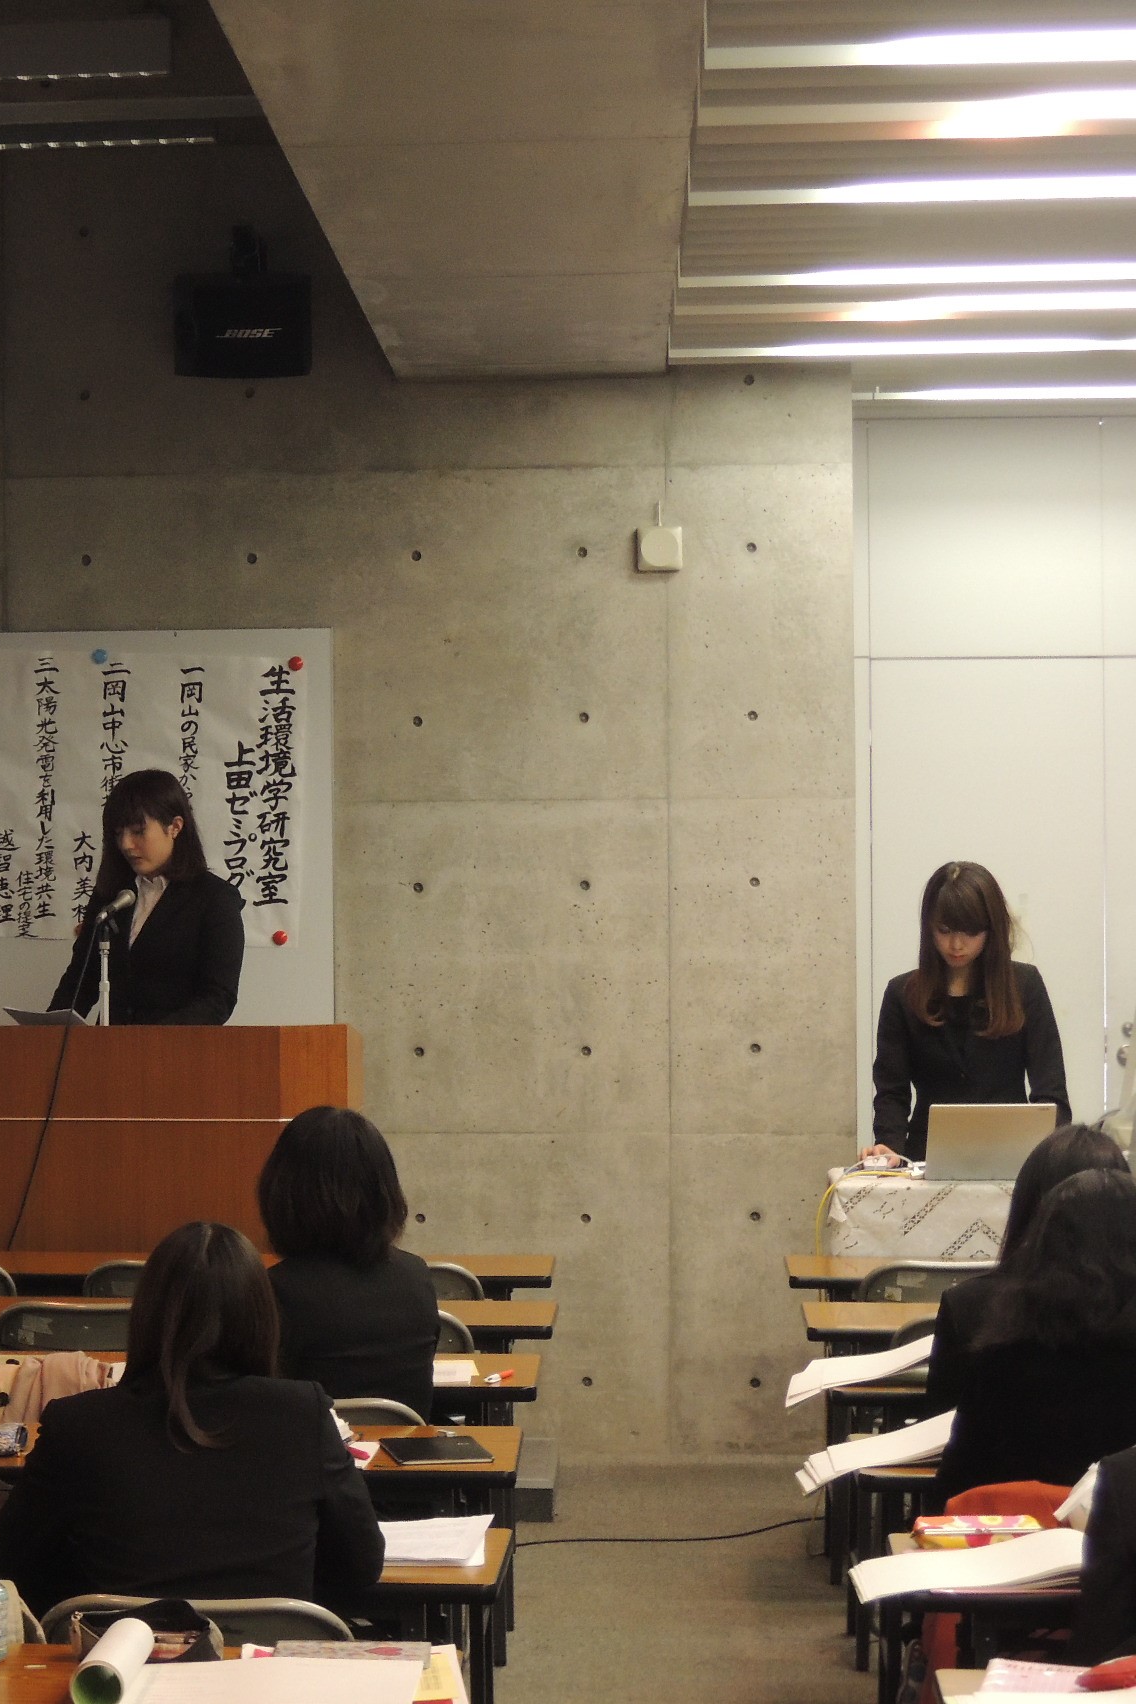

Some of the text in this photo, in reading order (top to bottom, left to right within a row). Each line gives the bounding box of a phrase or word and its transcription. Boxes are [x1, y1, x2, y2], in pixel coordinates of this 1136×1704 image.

[215, 327, 283, 338] BOSE
[177, 665, 206, 811] 一岡山の民家から
[253, 664, 298, 906] 生活環境学研究室
